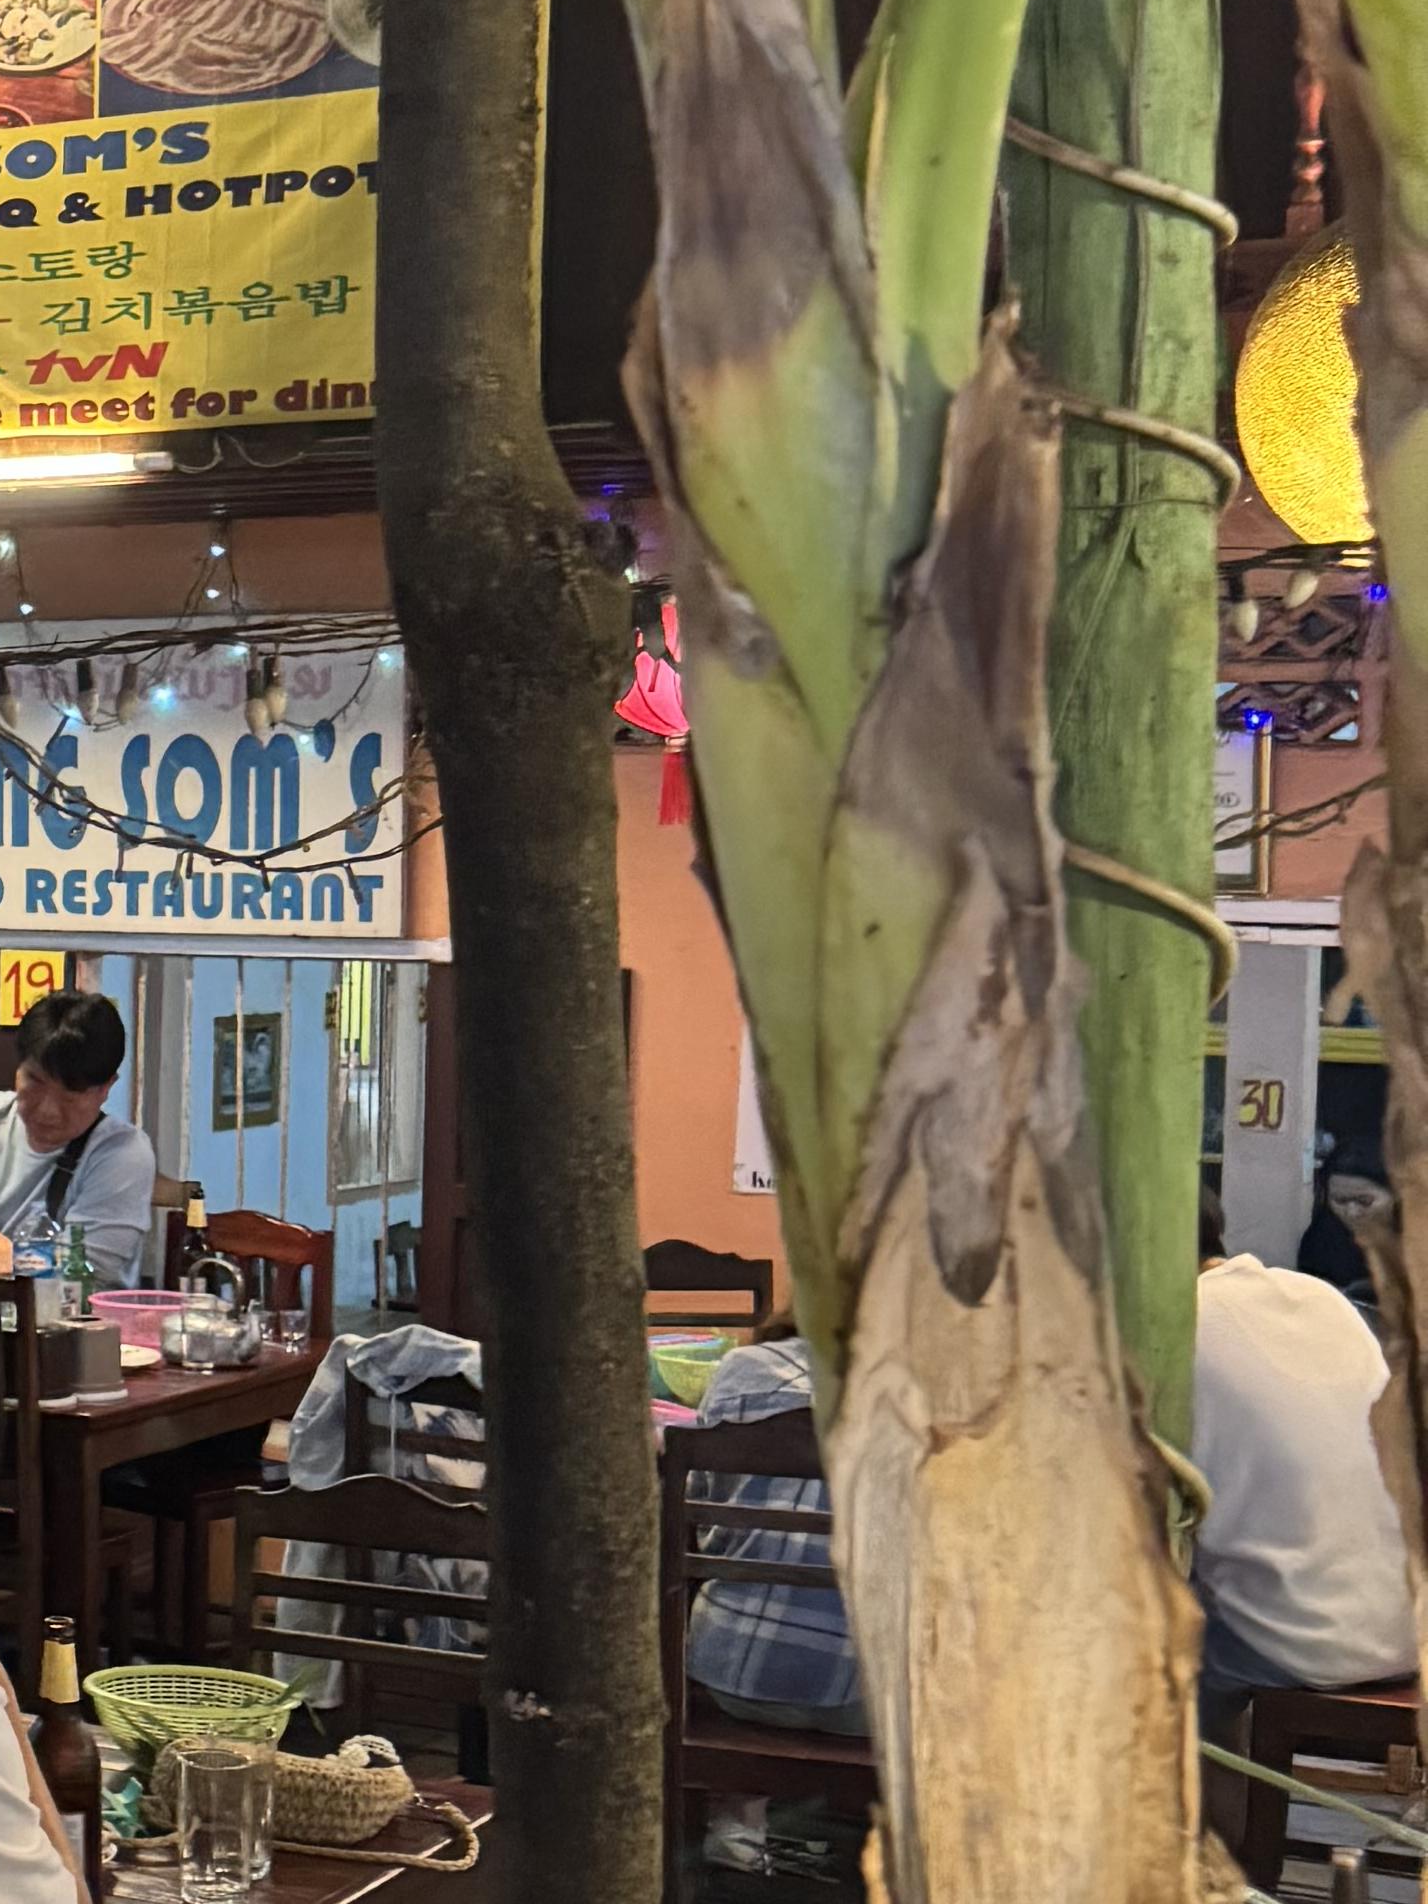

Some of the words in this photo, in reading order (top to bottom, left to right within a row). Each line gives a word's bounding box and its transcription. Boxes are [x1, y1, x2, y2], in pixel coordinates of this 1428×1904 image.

[58, 192, 102, 224] &
[38, 274, 361, 335] 김치볶음밥
[24, 340, 170, 385] tvN
[18, 390, 156, 428] meet
[170, 386, 258, 419] for
[274, 377, 376, 412] din
[116, 718, 382, 855] SOM'S
[25, 868, 384, 923] RESTAURANT
[3, 959, 56, 1020] 19
[1239, 1079, 1285, 1130] 30
